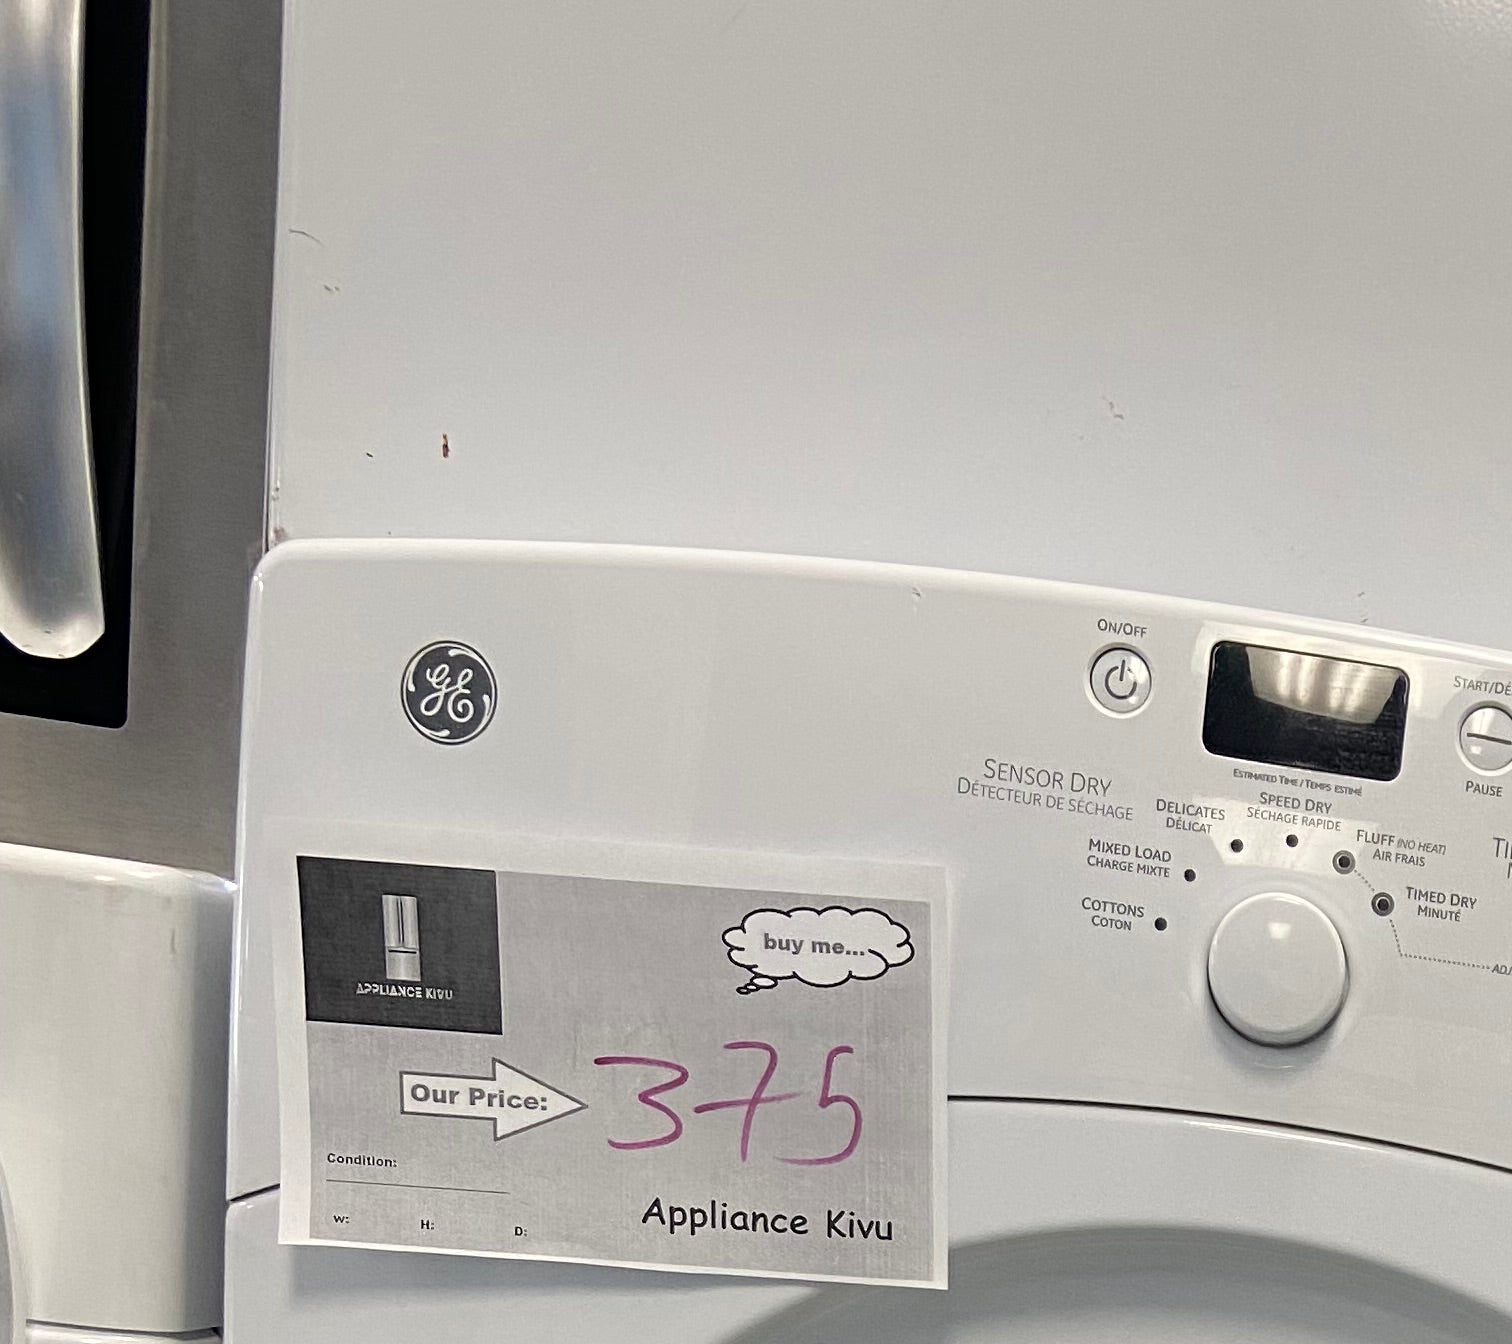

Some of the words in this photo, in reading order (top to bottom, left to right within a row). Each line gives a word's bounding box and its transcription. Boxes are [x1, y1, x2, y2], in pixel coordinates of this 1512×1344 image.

[1097, 618, 1147, 638] ON/OFF
[984, 758, 1064, 791] SENSOR
[1070, 772, 1112, 798] DRY
[1465, 780, 1503, 798] PAUSE
[957, 776, 1042, 808] DÉTECTEUR
[1046, 794, 1065, 811] DE
[1068, 796, 1134, 822] SÉCHAGE
[1156, 798, 1225, 821] DELICATES
[1259, 791, 1301, 810] SPEED
[1304, 799, 1333, 815] DRY
[1166, 815, 1213, 835] DÉLICAT
[1247, 806, 1299, 826] SÉCHAGE
[1301, 815, 1342, 832] RAPIDE
[1356, 829, 1395, 847] FLUFF
[1088, 838, 1131, 859] MIXED
[1134, 844, 1172, 863] LOAD
[1372, 848, 1393, 862] AIR
[1394, 852, 1426, 868] FRAIS
[1087, 853, 1134, 875] CHARGE
[1135, 861, 1171, 879] MIXTE
[1081, 897, 1145, 920] COTTONS
[1406, 886, 1447, 907] TIMED
[1449, 891, 1478, 911] DRY
[1091, 914, 1133, 932] COTON
[1416, 904, 1463, 923] MINUTÉ
[763, 932, 805, 957] buy
[811, 937, 866, 958] me...
[356, 982, 423, 999] APPLIANCE
[425, 987, 453, 1001] KIVU
[410, 1083, 460, 1106] Our
[469, 1086, 548, 1111] Price:
[593, 1040, 863, 1165] 375
[327, 1152, 398, 1168] Condition:
[641, 1197, 808, 1237] Appliance
[825, 1207, 894, 1241] Kivu
